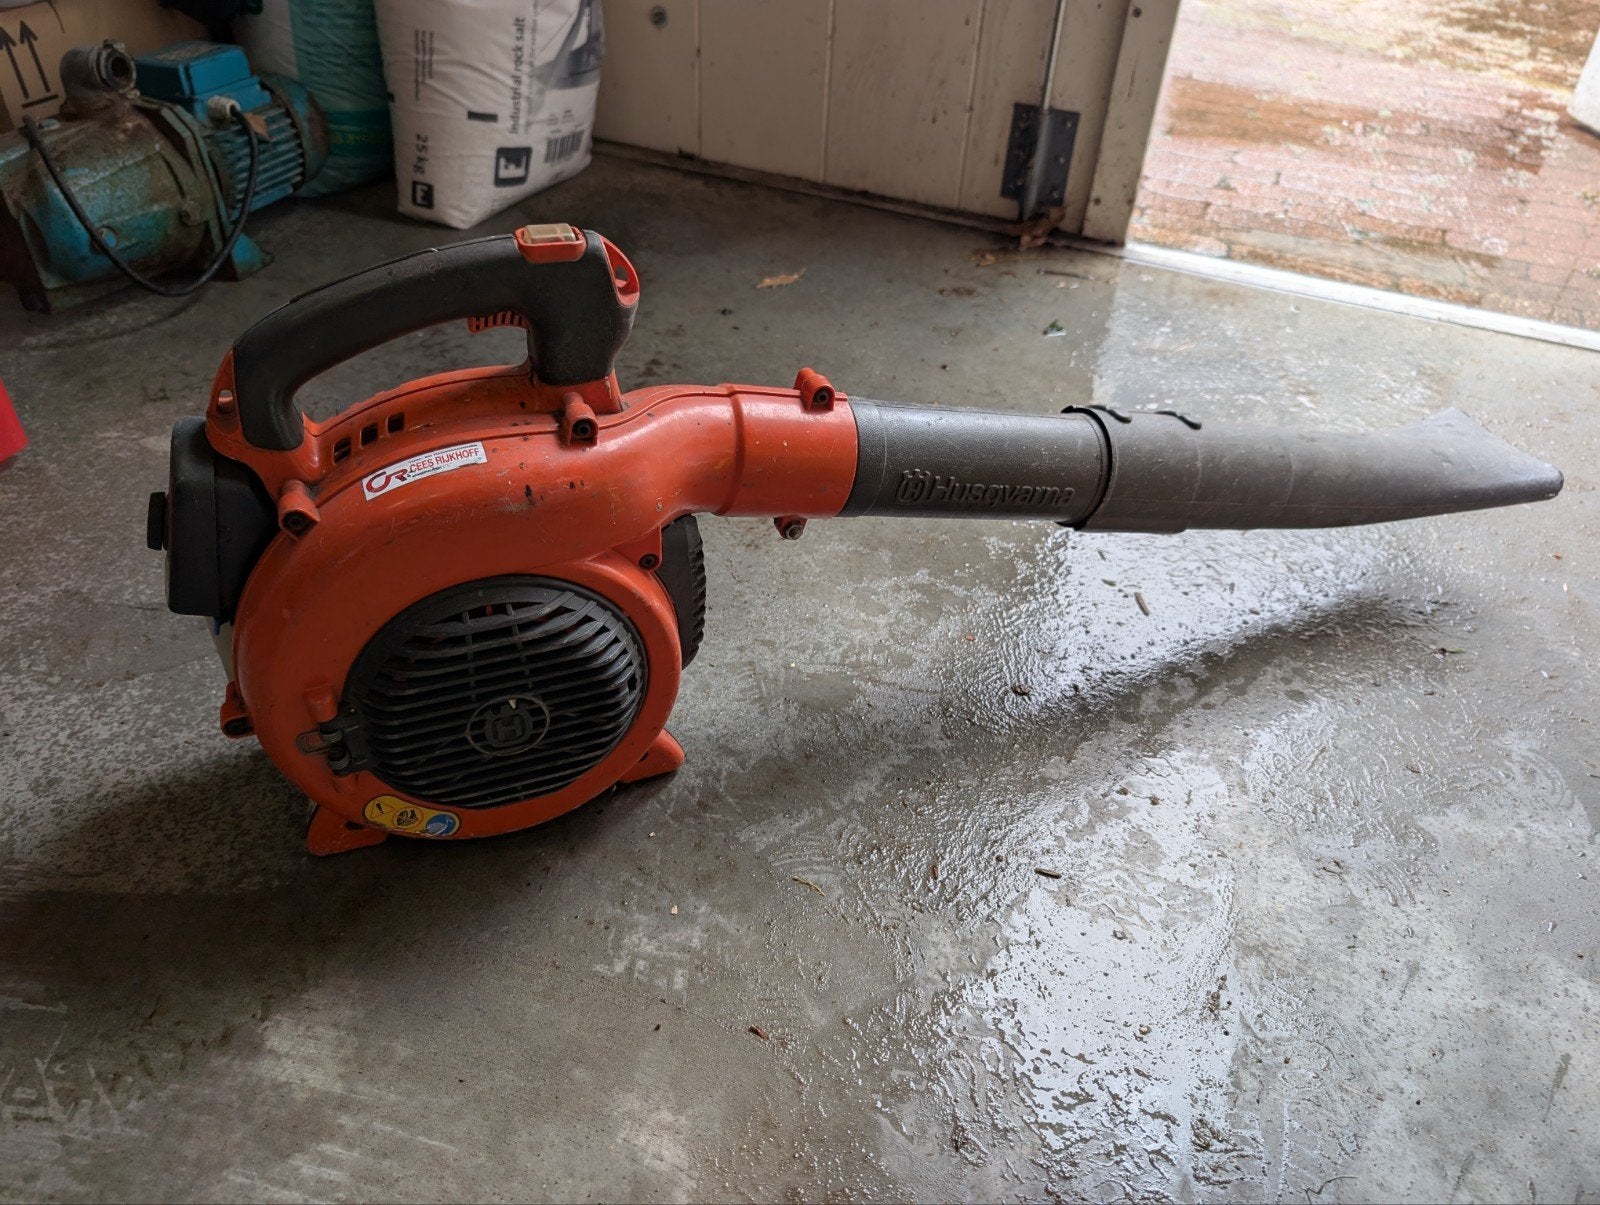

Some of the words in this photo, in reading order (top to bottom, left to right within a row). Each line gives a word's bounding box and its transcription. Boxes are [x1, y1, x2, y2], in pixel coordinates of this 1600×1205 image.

[513, 16, 525, 41] salt
[415, 133, 429, 153] 25
[435, 447, 480, 465] RIJKHOFF
[928, 475, 1075, 507] Husqvarna
